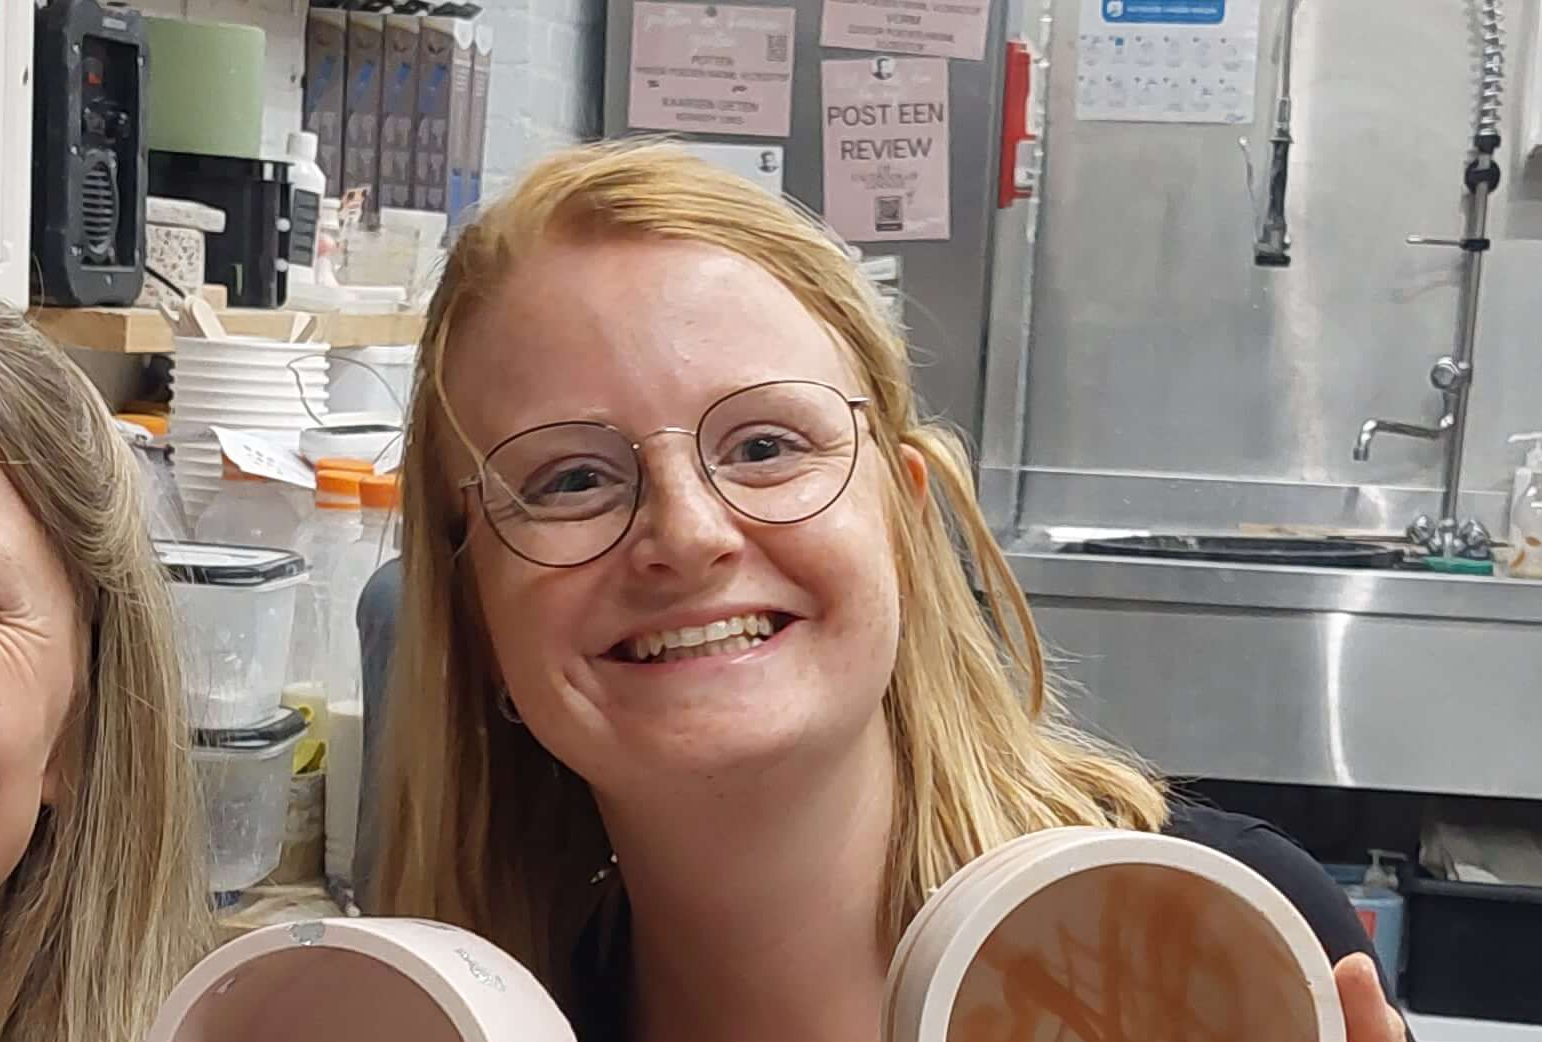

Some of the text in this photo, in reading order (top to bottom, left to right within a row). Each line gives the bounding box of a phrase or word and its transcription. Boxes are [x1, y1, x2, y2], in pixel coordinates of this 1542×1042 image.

[827, 103, 944, 126] POST EEN
[841, 138, 932, 160] REVIEW
